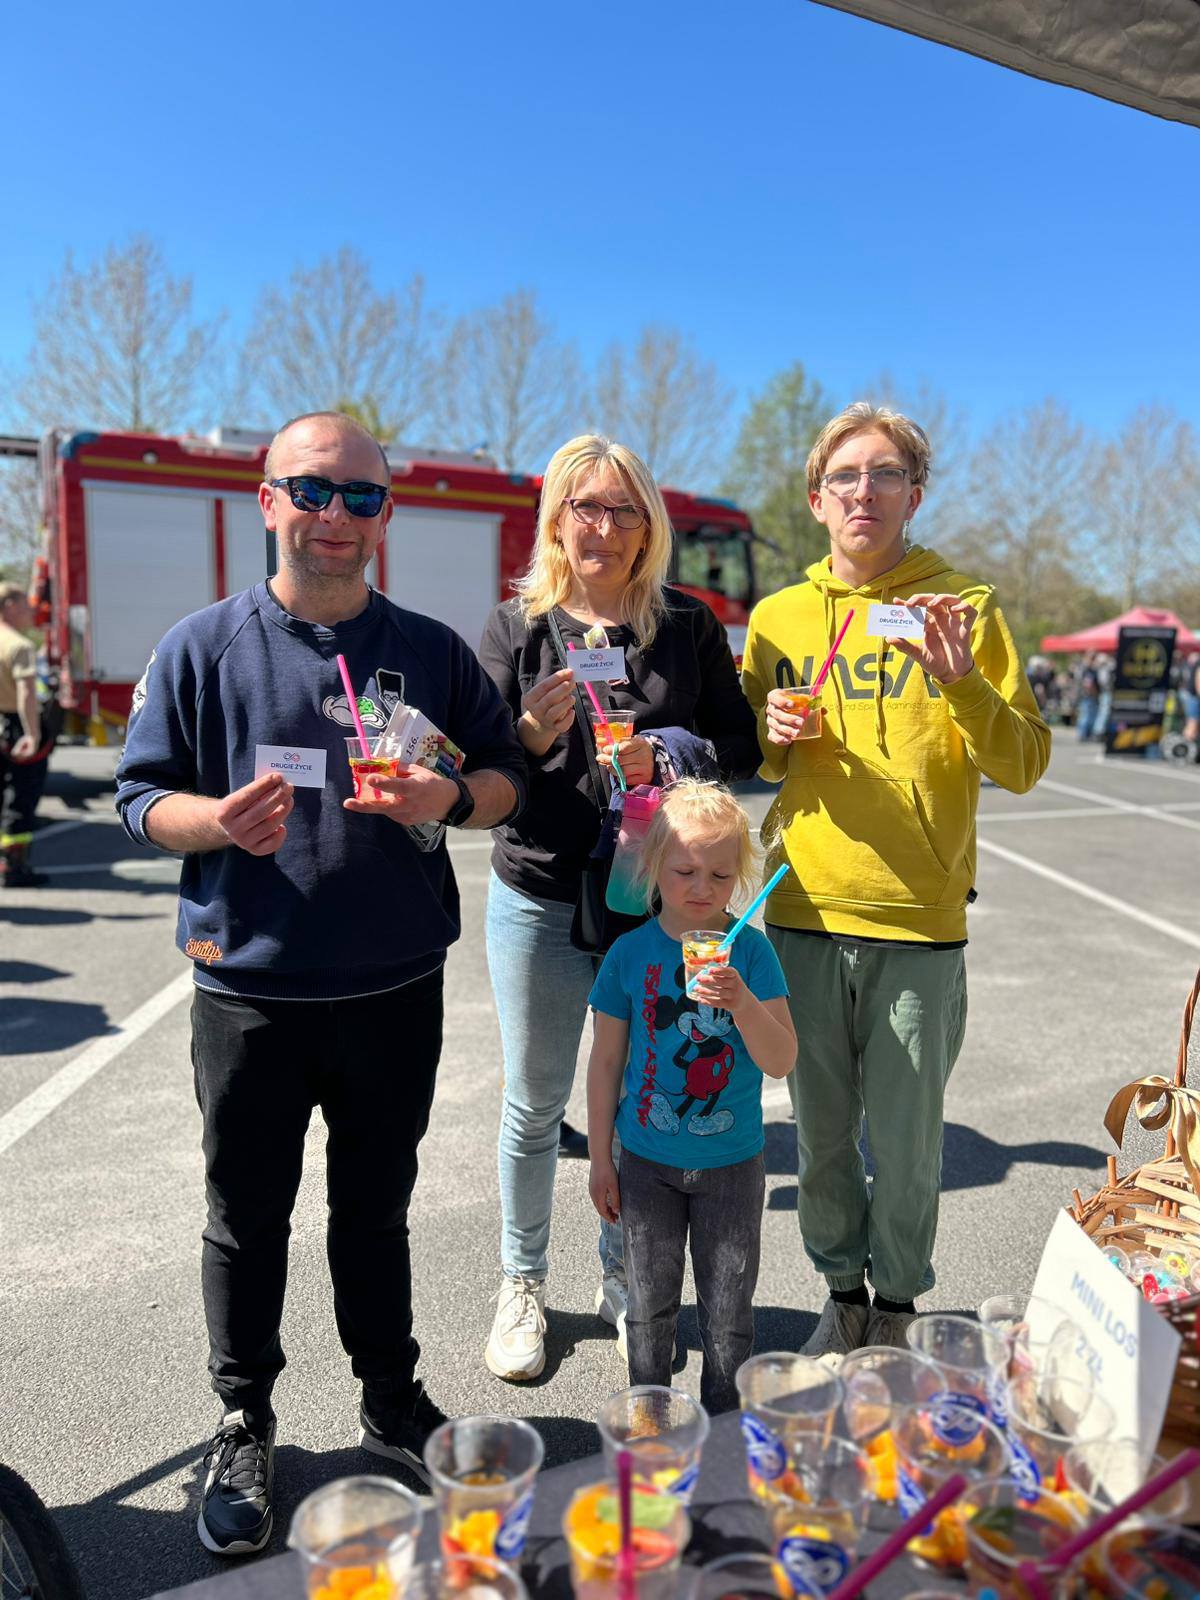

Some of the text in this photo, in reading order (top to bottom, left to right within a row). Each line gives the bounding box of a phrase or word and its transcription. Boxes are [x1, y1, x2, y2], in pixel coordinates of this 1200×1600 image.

[776, 652, 942, 700] NASA
[641, 962, 662, 1045] MOUSE
[1071, 1271, 1137, 1358] MINI LOS
